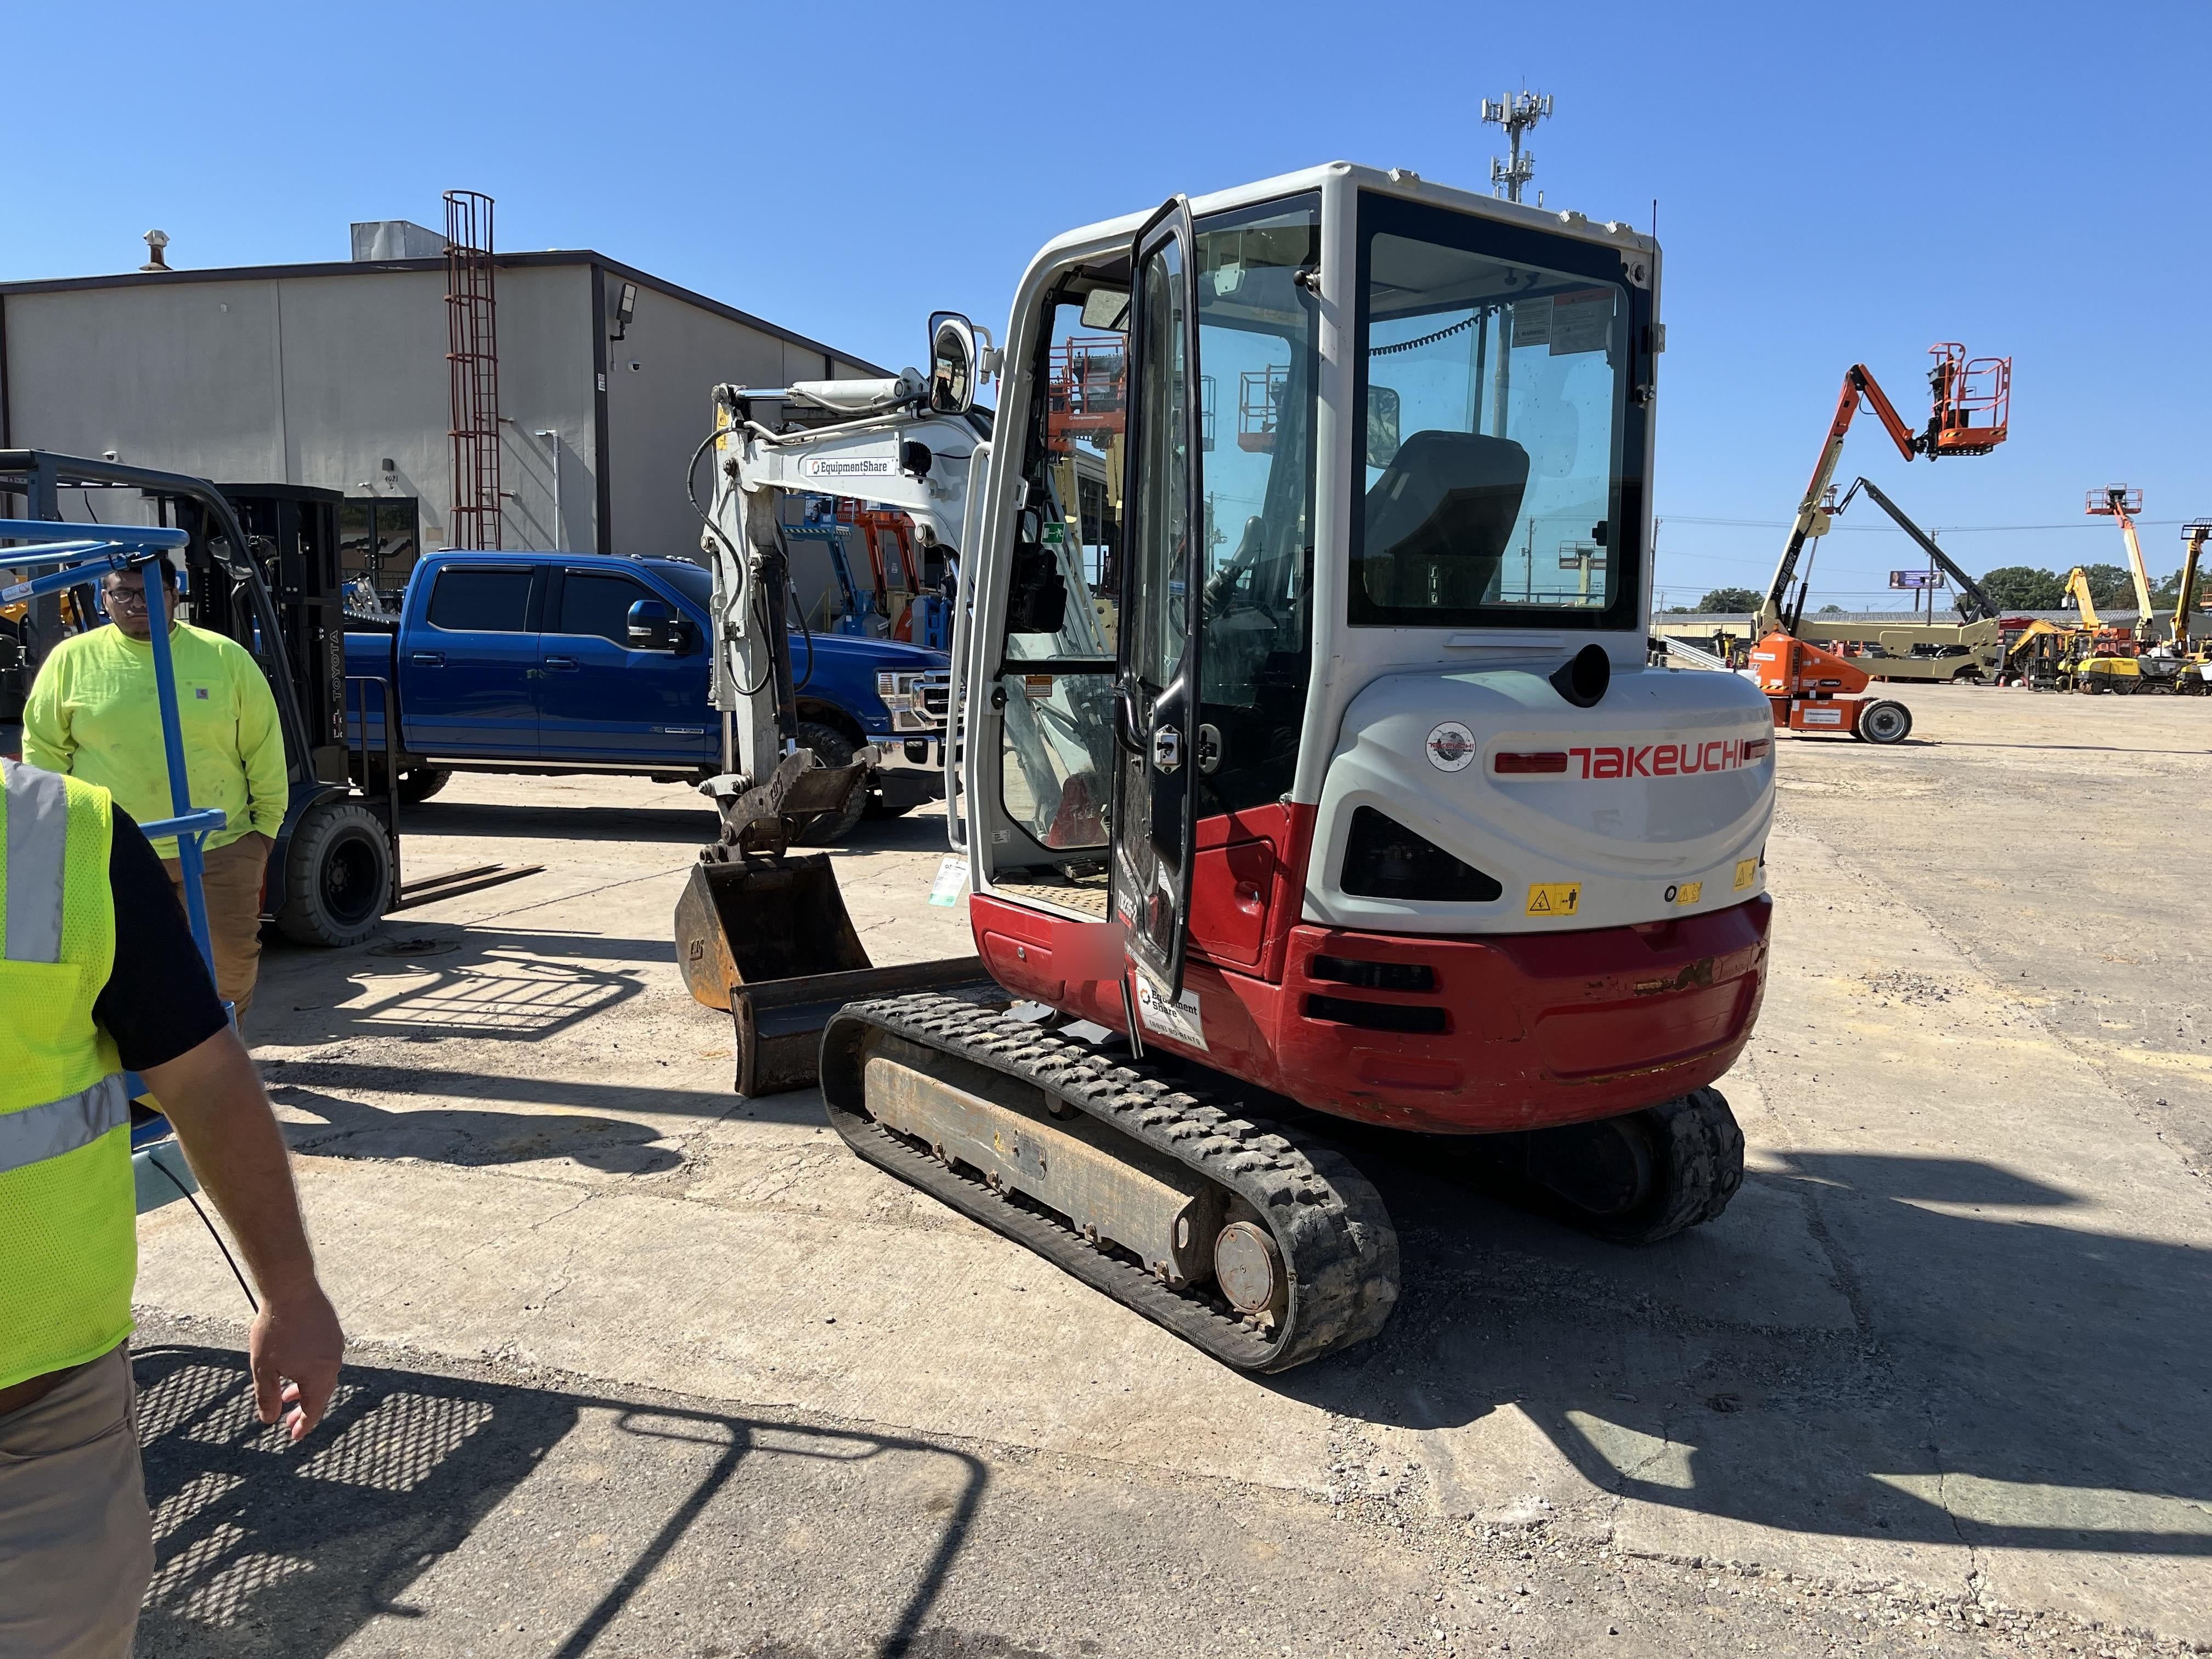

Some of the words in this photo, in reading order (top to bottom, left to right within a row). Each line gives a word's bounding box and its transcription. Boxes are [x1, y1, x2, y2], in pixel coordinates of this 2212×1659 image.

[821, 461, 887, 475] EquipmentShare
[1778, 572, 1788, 590] JLG
[1784, 552, 1797, 574] LIFT
[330, 630, 341, 702] TOYOTA
[1152, 990, 1198, 1015] Equment
[1152, 1001, 1177, 1018] Share
